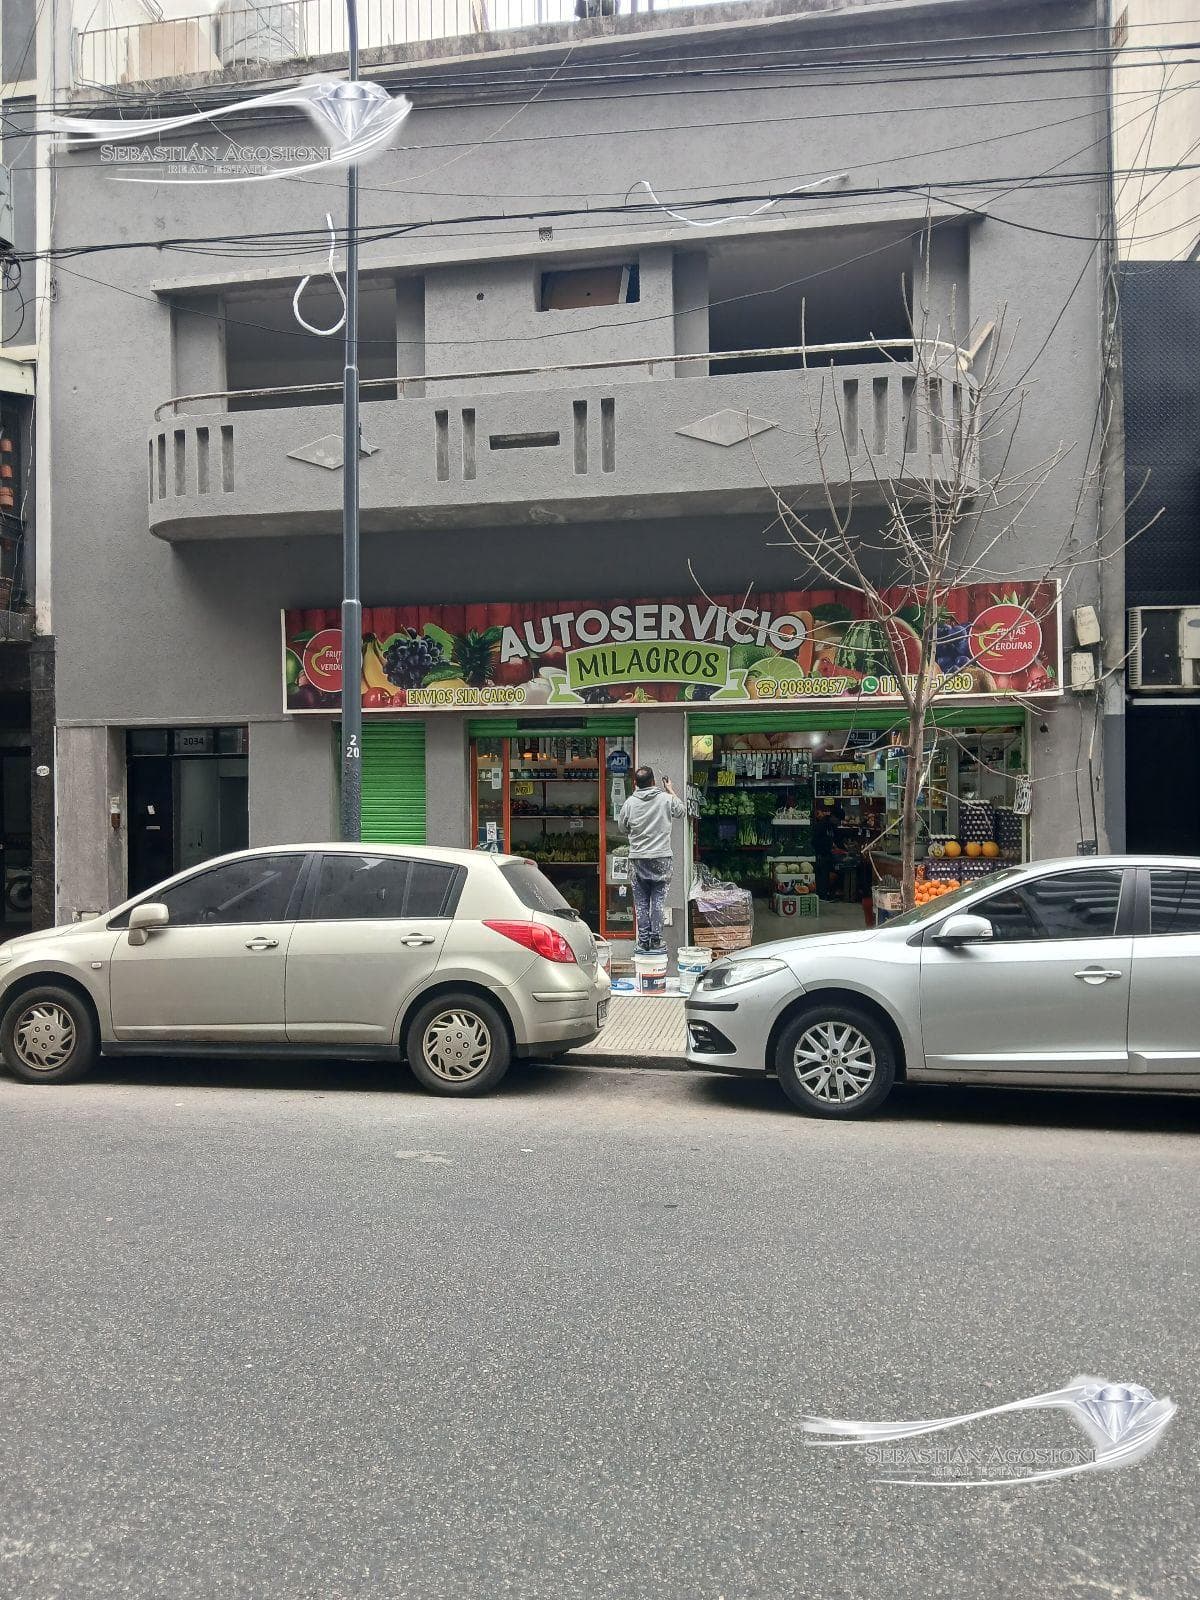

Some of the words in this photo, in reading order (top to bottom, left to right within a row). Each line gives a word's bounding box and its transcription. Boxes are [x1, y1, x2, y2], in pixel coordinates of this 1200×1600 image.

[500, 604, 807, 663] AUTOSERVICIO
[320, 663, 343, 671] VERDU
[576, 648, 719, 681] MILAGROS
[780, 678, 847, 695] 90886857
[407, 689, 453, 704] ENVIOS
[456, 689, 479, 703] SIN
[480, 688, 525, 703] CARGO
[183, 737, 204, 746] 2034
[350, 735, 357, 745] 2
[346, 747, 360, 757] 20
[610, 756, 628, 767] ADT
